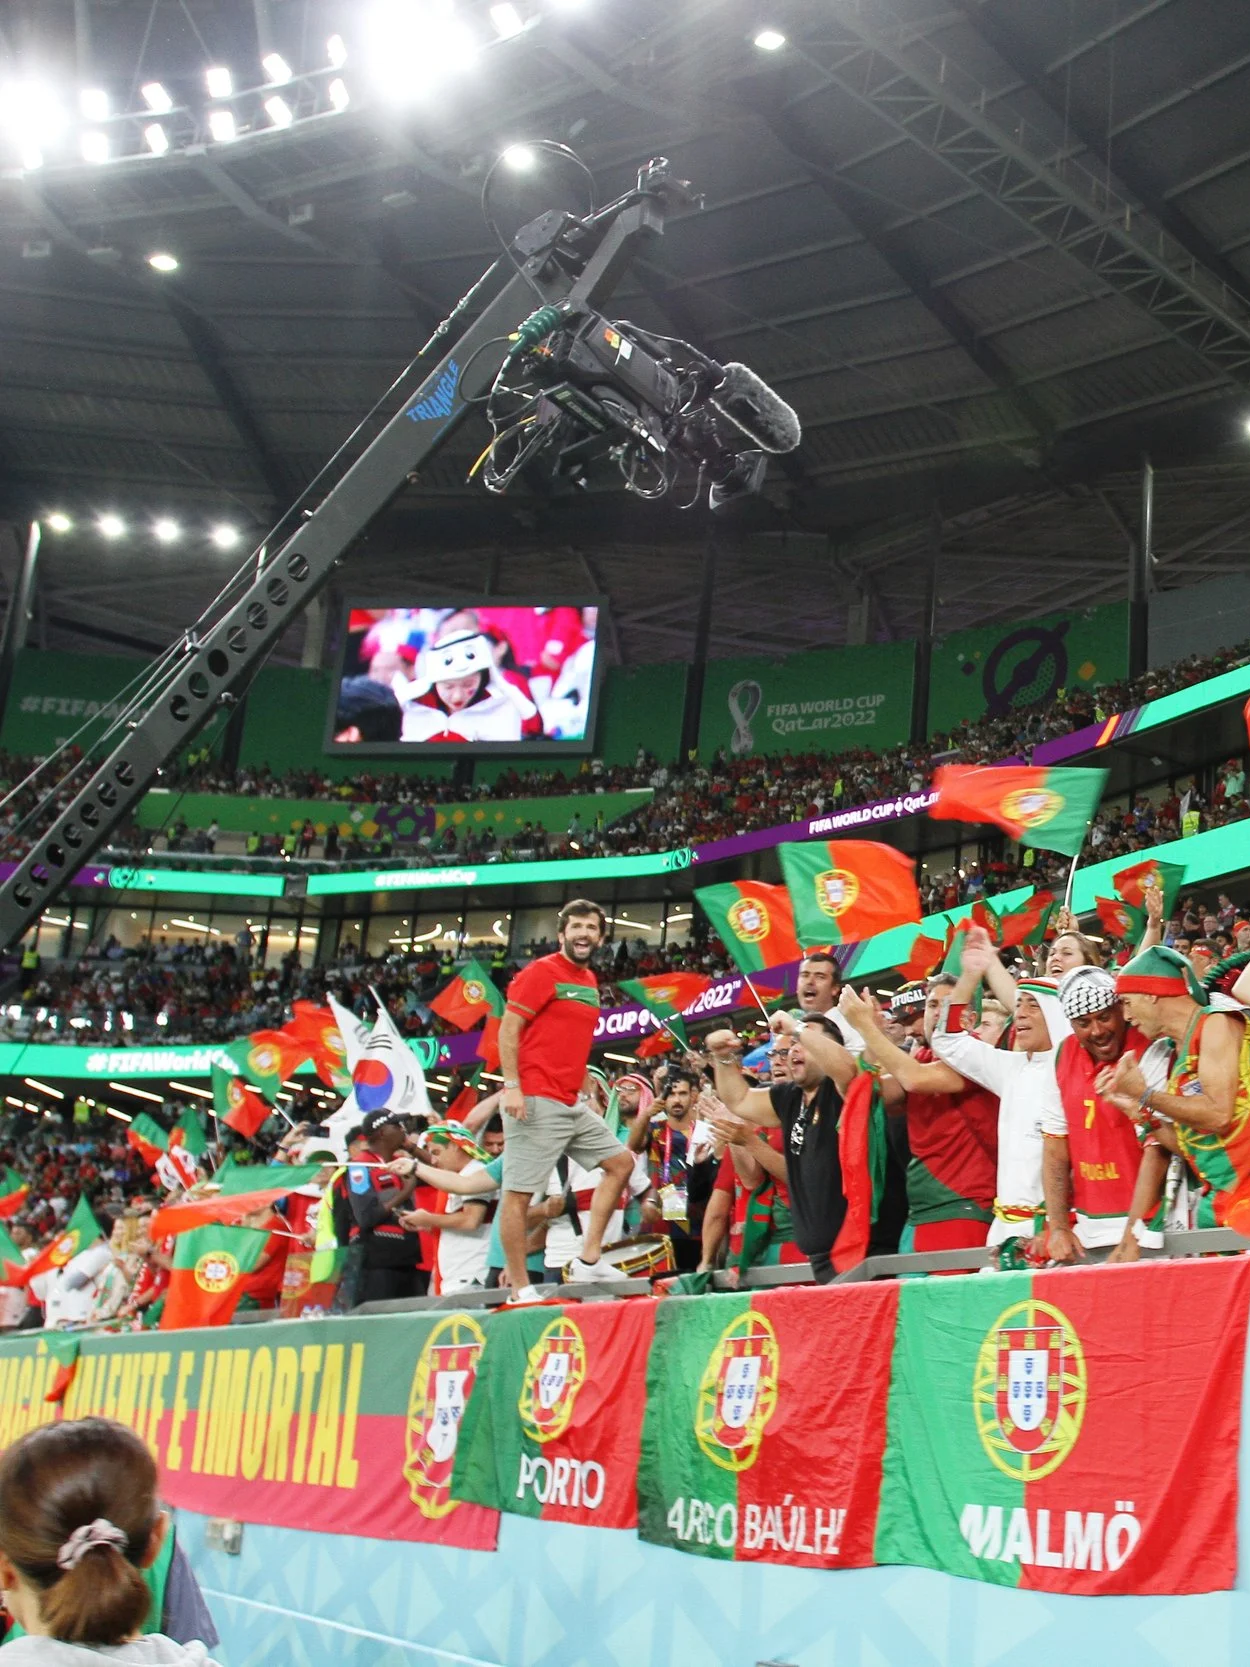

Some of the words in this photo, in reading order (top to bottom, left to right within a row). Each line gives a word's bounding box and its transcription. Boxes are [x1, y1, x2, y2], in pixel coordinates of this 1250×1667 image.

[406, 359, 459, 421] TRIANGLE
[767, 703, 798, 717] FIFA
[800, 698, 854, 714] WORLD
[856, 694, 885, 708] CUP
[809, 819, 832, 834] FIFA
[832, 808, 872, 828] WORLD
[872, 802, 895, 819] CUP
[606, 1011, 637, 1034] CUP
[1083, 1099, 1095, 1129] 7
[166, 1351, 194, 1470] E
[191, 1343, 365, 1488] IMORTAL
[516, 1453, 606, 1509] PORTO
[959, 1500, 1142, 1572] MALMÖ
